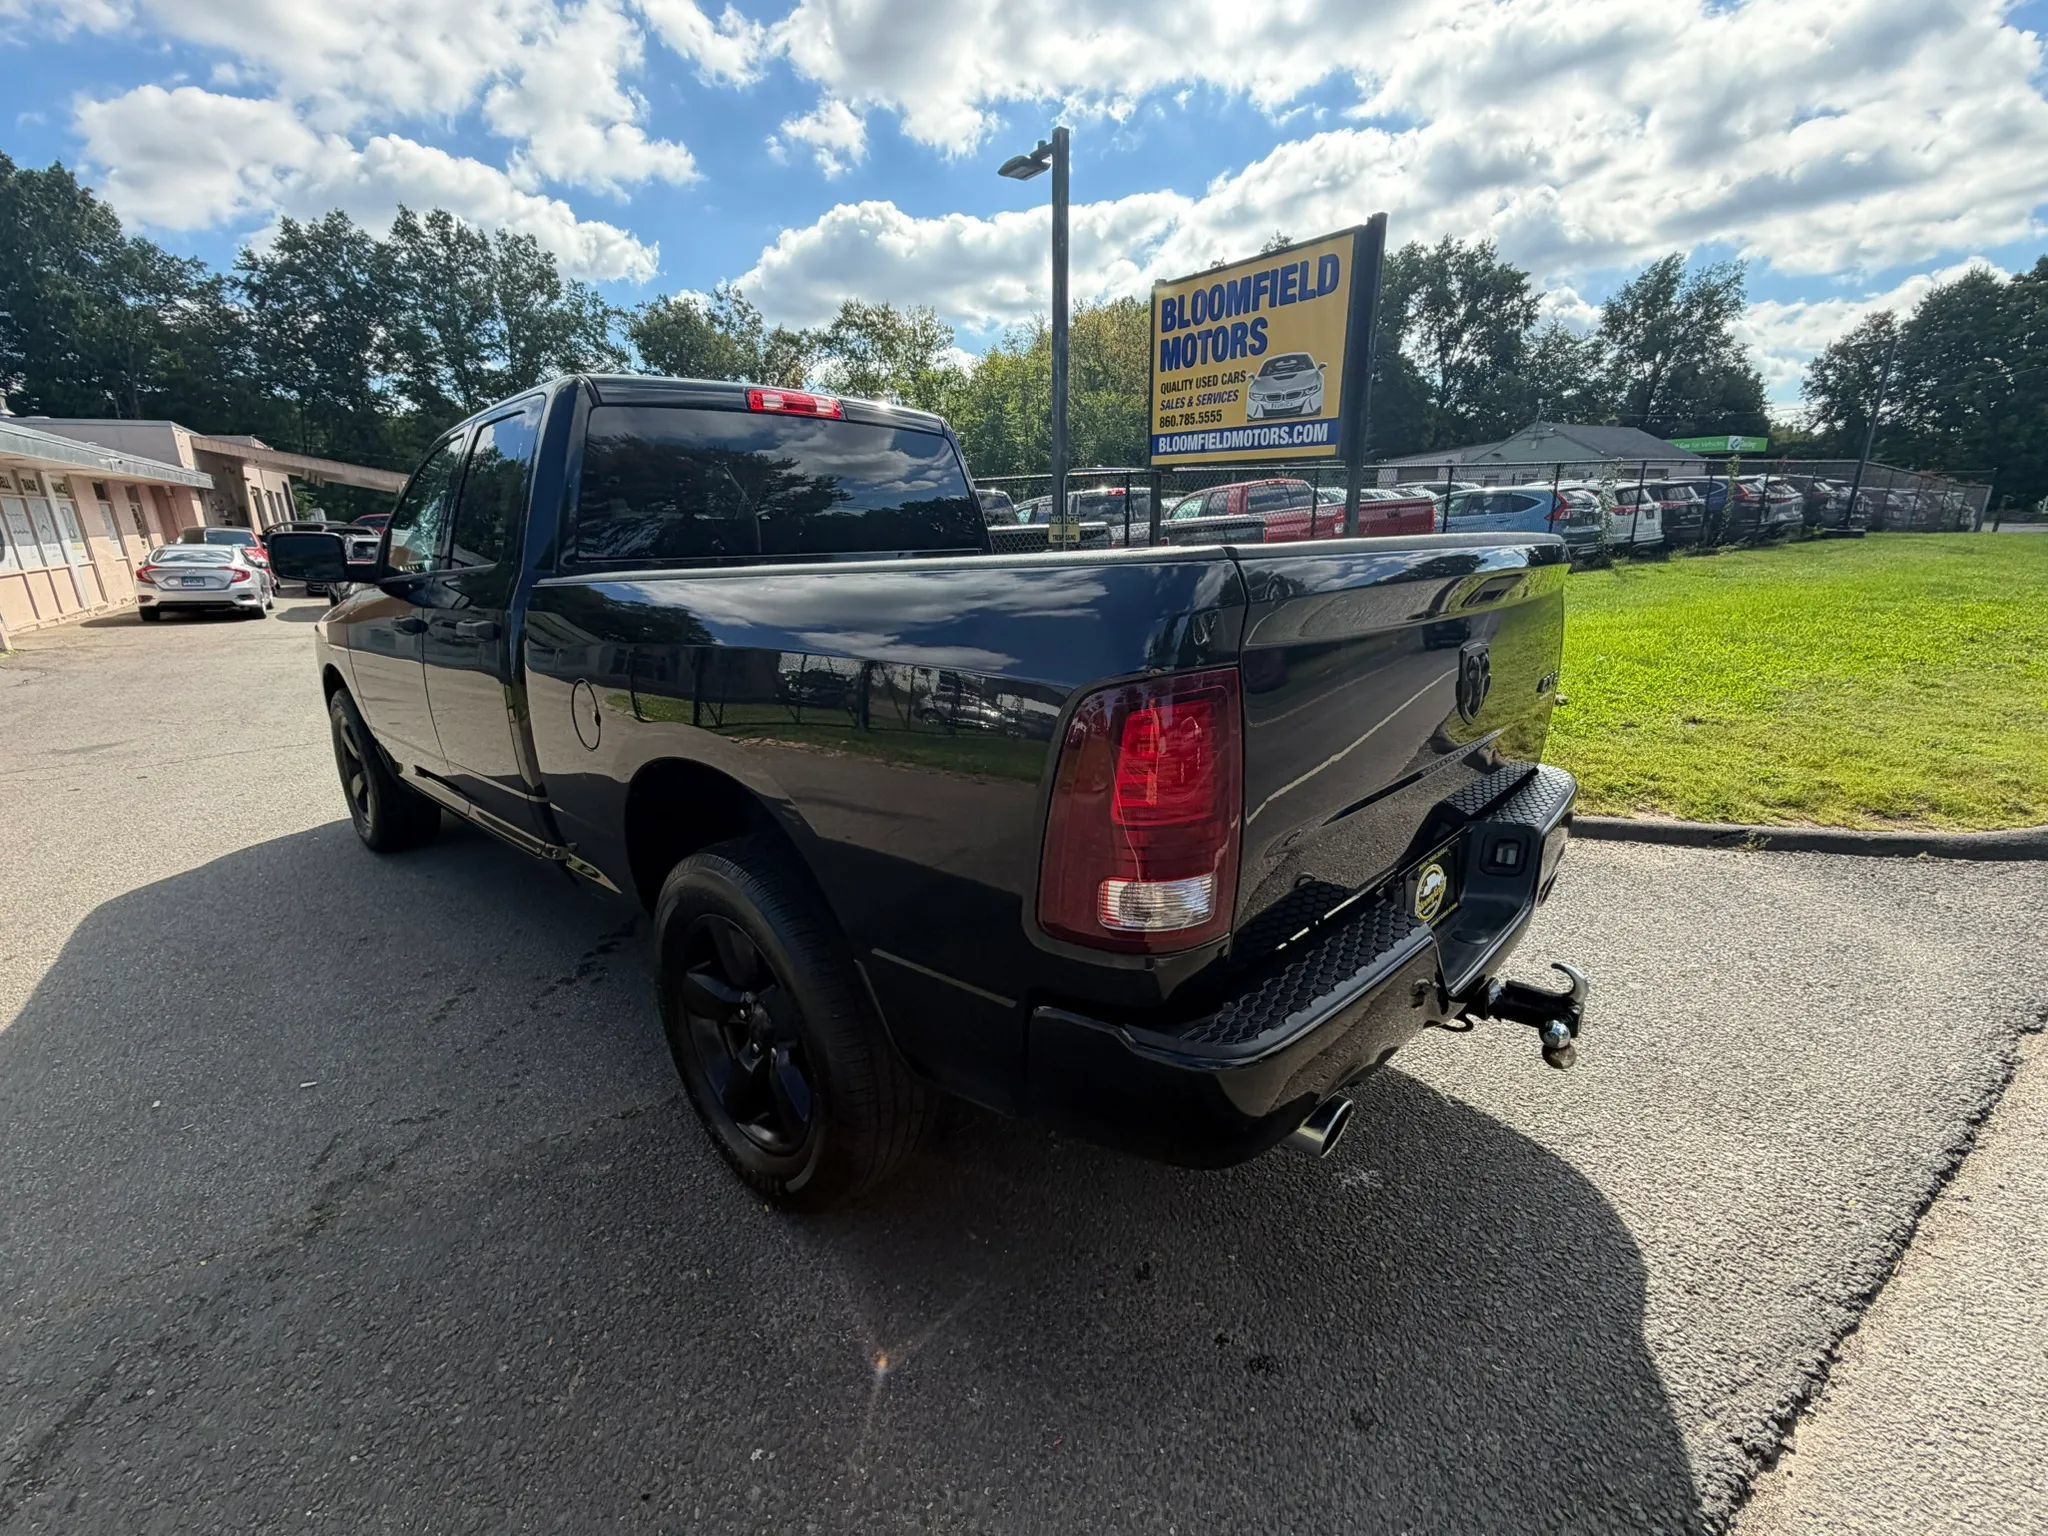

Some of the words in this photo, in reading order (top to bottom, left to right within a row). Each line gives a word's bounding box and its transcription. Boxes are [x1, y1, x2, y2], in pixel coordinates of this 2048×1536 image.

[1161, 253, 1340, 333] BLOOMFIELD
[1160, 317, 1268, 372] MOTORS
[1160, 378, 1193, 394] QUALITY
[1196, 374, 1218, 389] USED
[1221, 370, 1246, 385] CARS
[1160, 396, 1185, 411] SALES
[1187, 396, 1194, 407] &
[1196, 389, 1239, 406] SERVICES
[1160, 409, 1222, 428] 860.785.5555
[1158, 422, 1328, 453] BLOOMFIELDMOTORS.COM
[1050, 515, 1079, 525] NOICE
